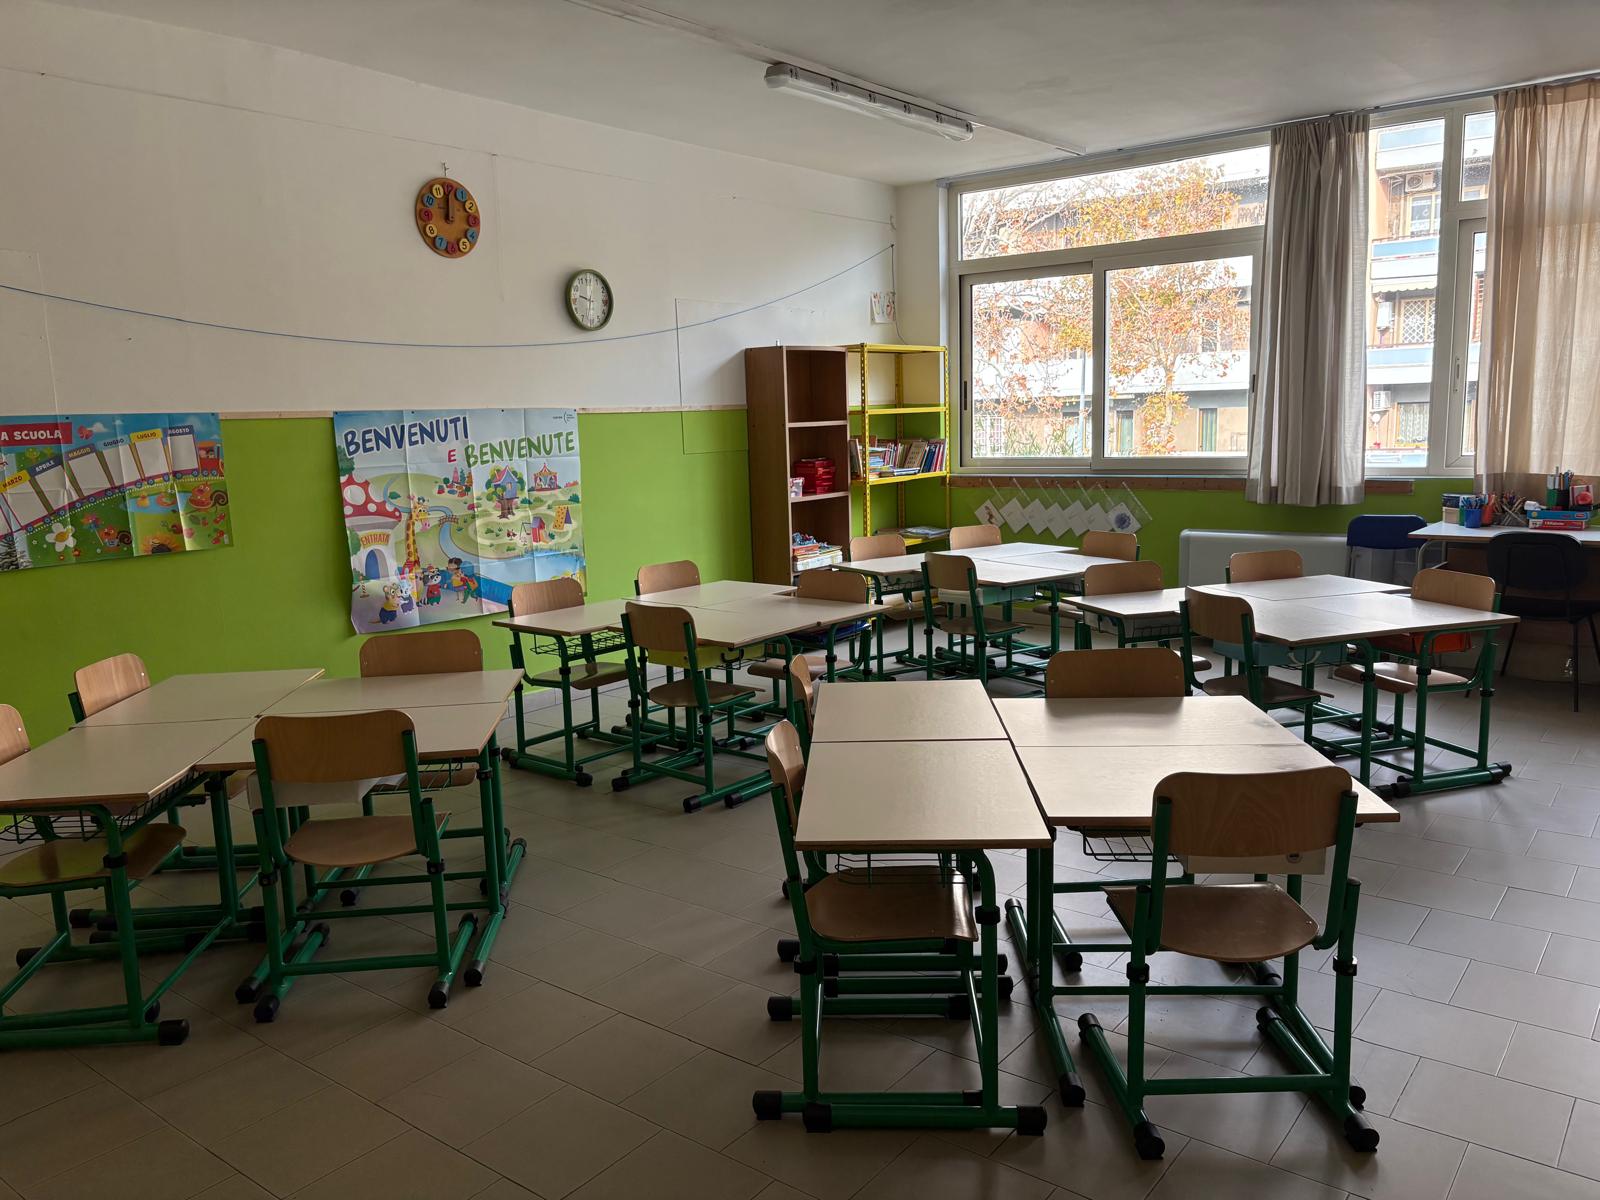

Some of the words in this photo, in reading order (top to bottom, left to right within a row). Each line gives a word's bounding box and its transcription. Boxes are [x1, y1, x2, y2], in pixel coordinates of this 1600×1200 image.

[13, 430, 62, 440] SCUOLA
[136, 431, 157, 440] LUGLIO
[343, 416, 469, 458] BENVENUTI
[103, 438, 125, 447] GIUGNO
[68, 447, 91, 458] MAGGIO
[447, 449, 457, 463] E
[463, 431, 575, 468] BENVENUTE
[35, 460, 55, 473] APRILE
[2, 475, 23, 489] MARZO
[360, 533, 391, 546] ENTRATA
